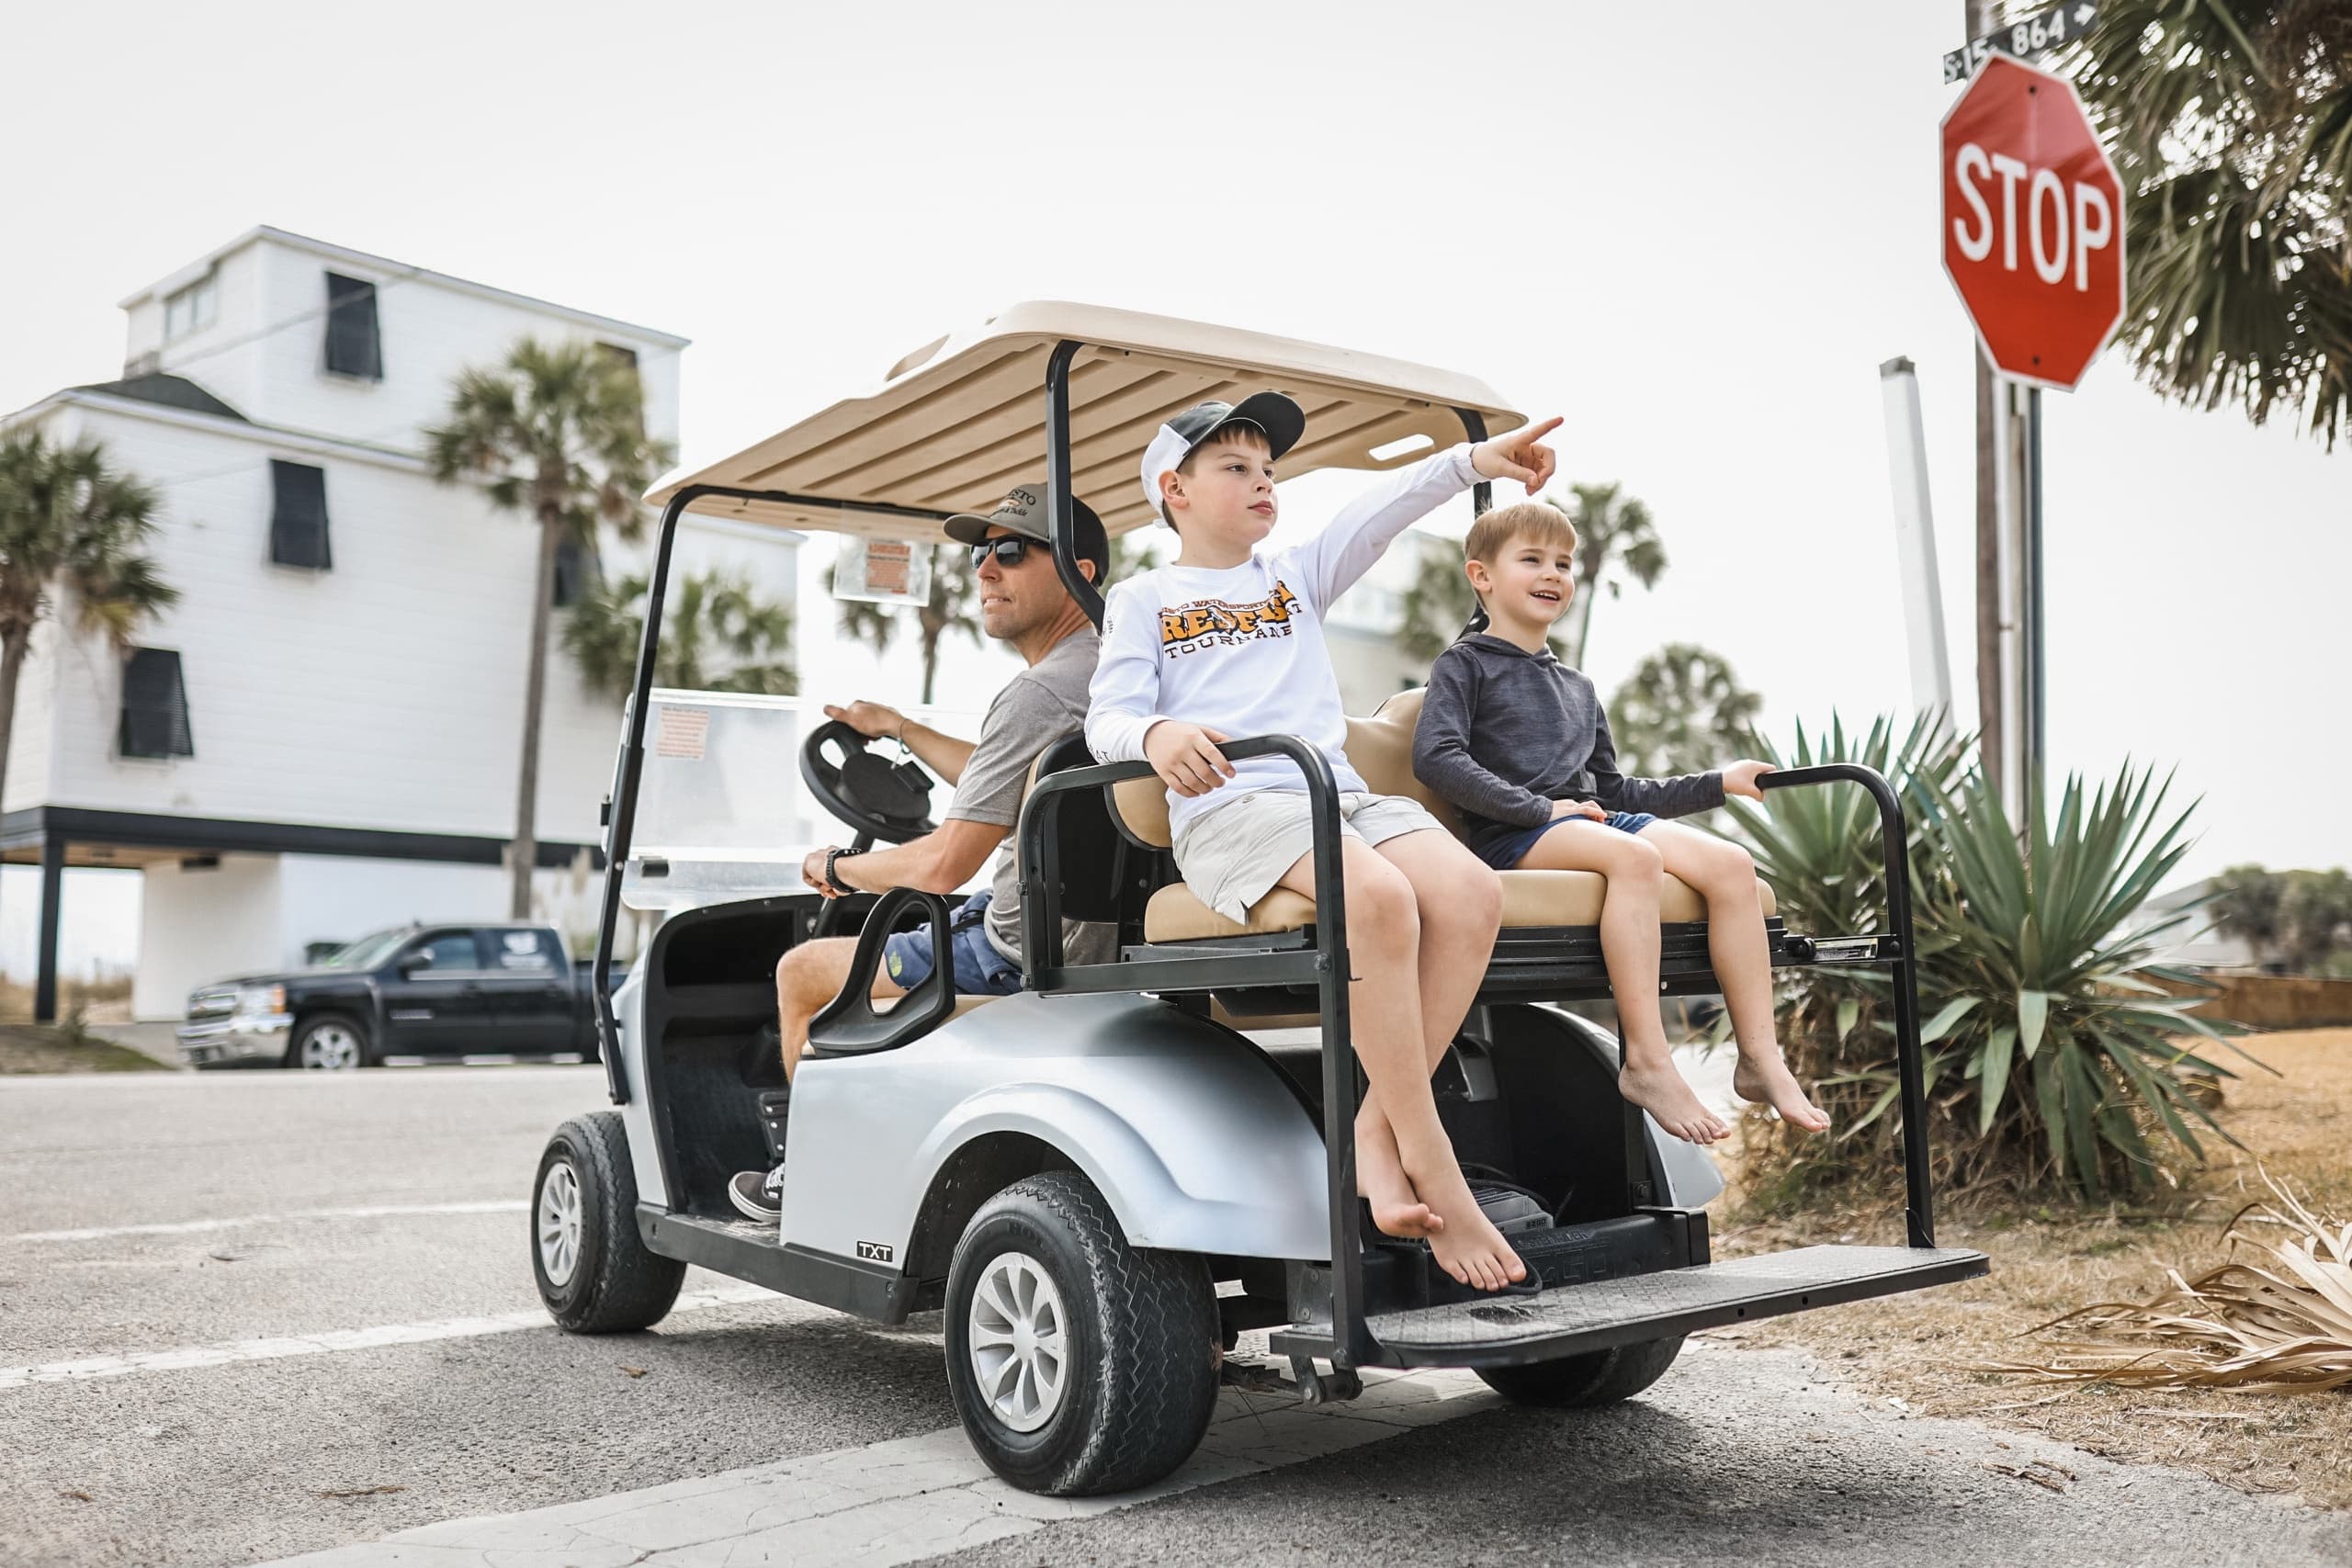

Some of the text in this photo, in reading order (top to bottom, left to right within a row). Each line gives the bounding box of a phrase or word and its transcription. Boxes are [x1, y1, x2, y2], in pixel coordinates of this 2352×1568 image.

[2012, 8, 2065, 56] 864
[1953, 142, 2112, 292] STOP
[858, 1242, 891, 1260] TXT
